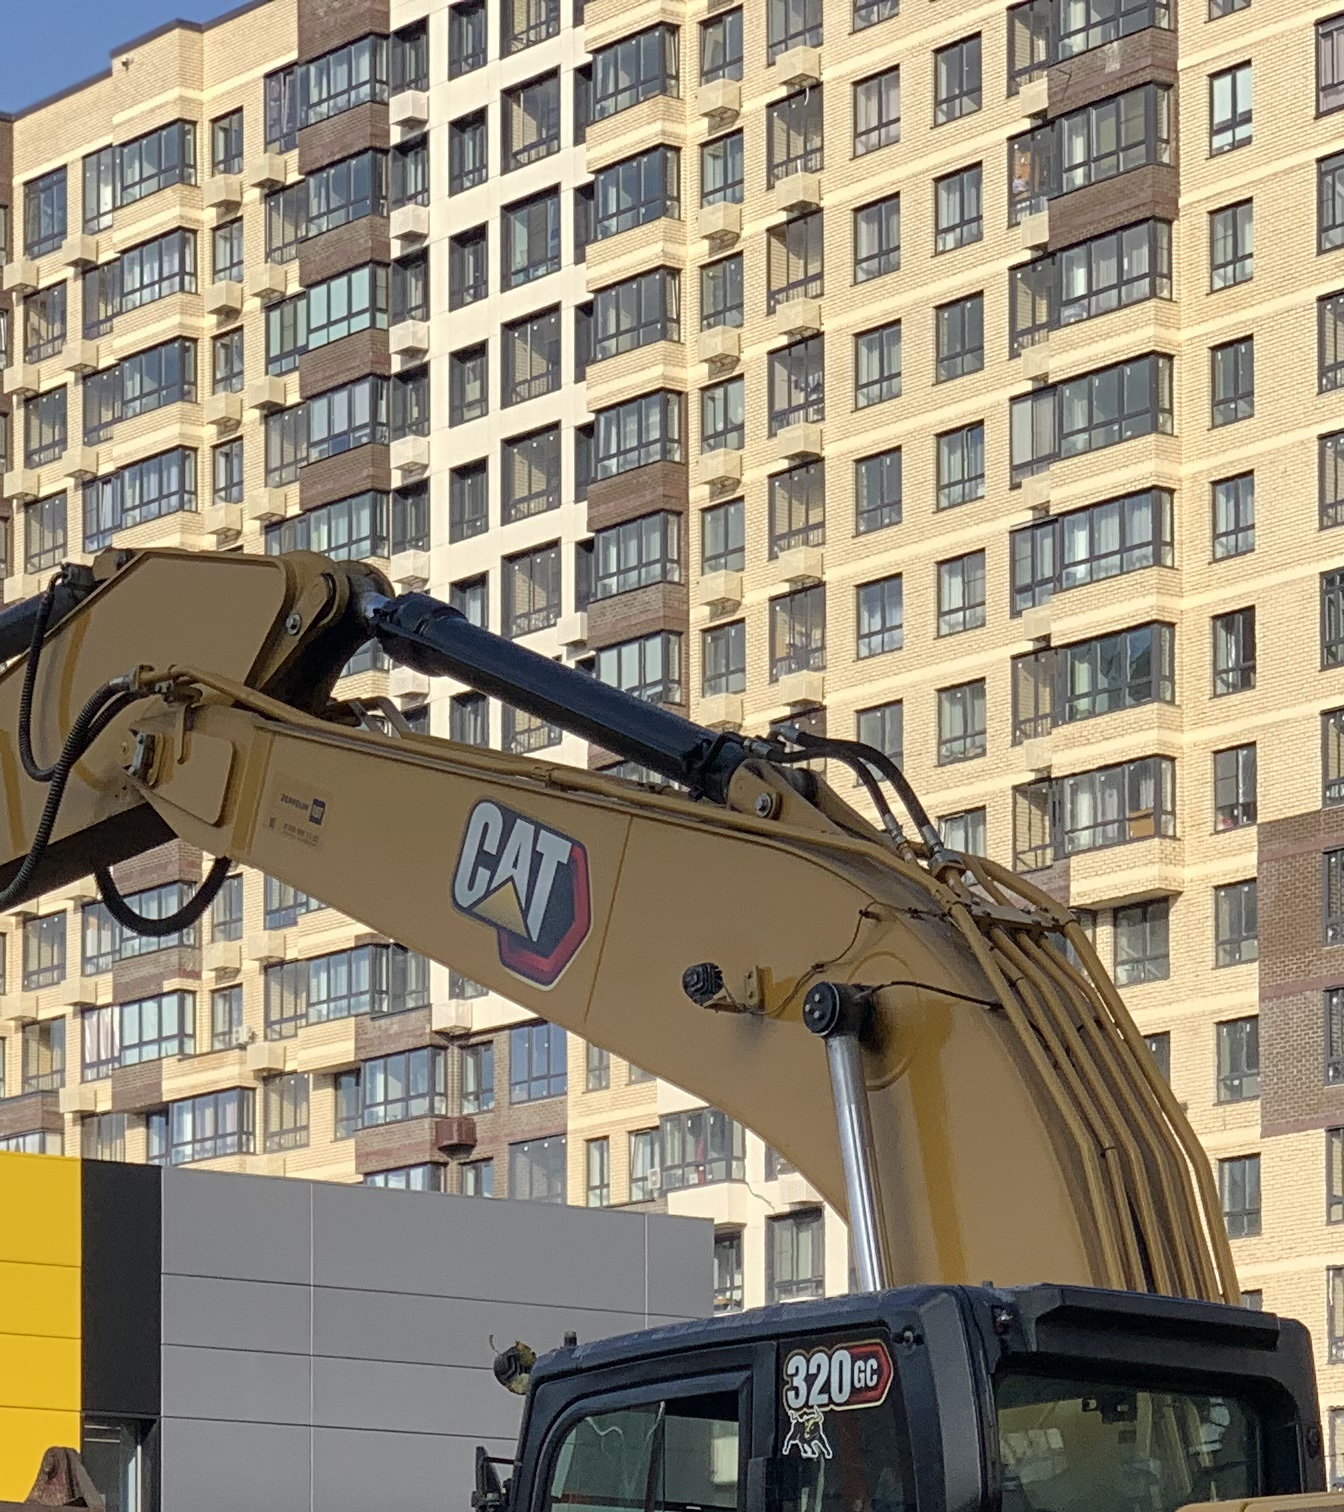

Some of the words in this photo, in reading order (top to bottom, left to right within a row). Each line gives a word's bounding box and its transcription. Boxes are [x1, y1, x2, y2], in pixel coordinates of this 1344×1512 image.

[454, 802, 572, 942] CAT
[787, 1349, 852, 1409] 320
[853, 1358, 878, 1388] GC
